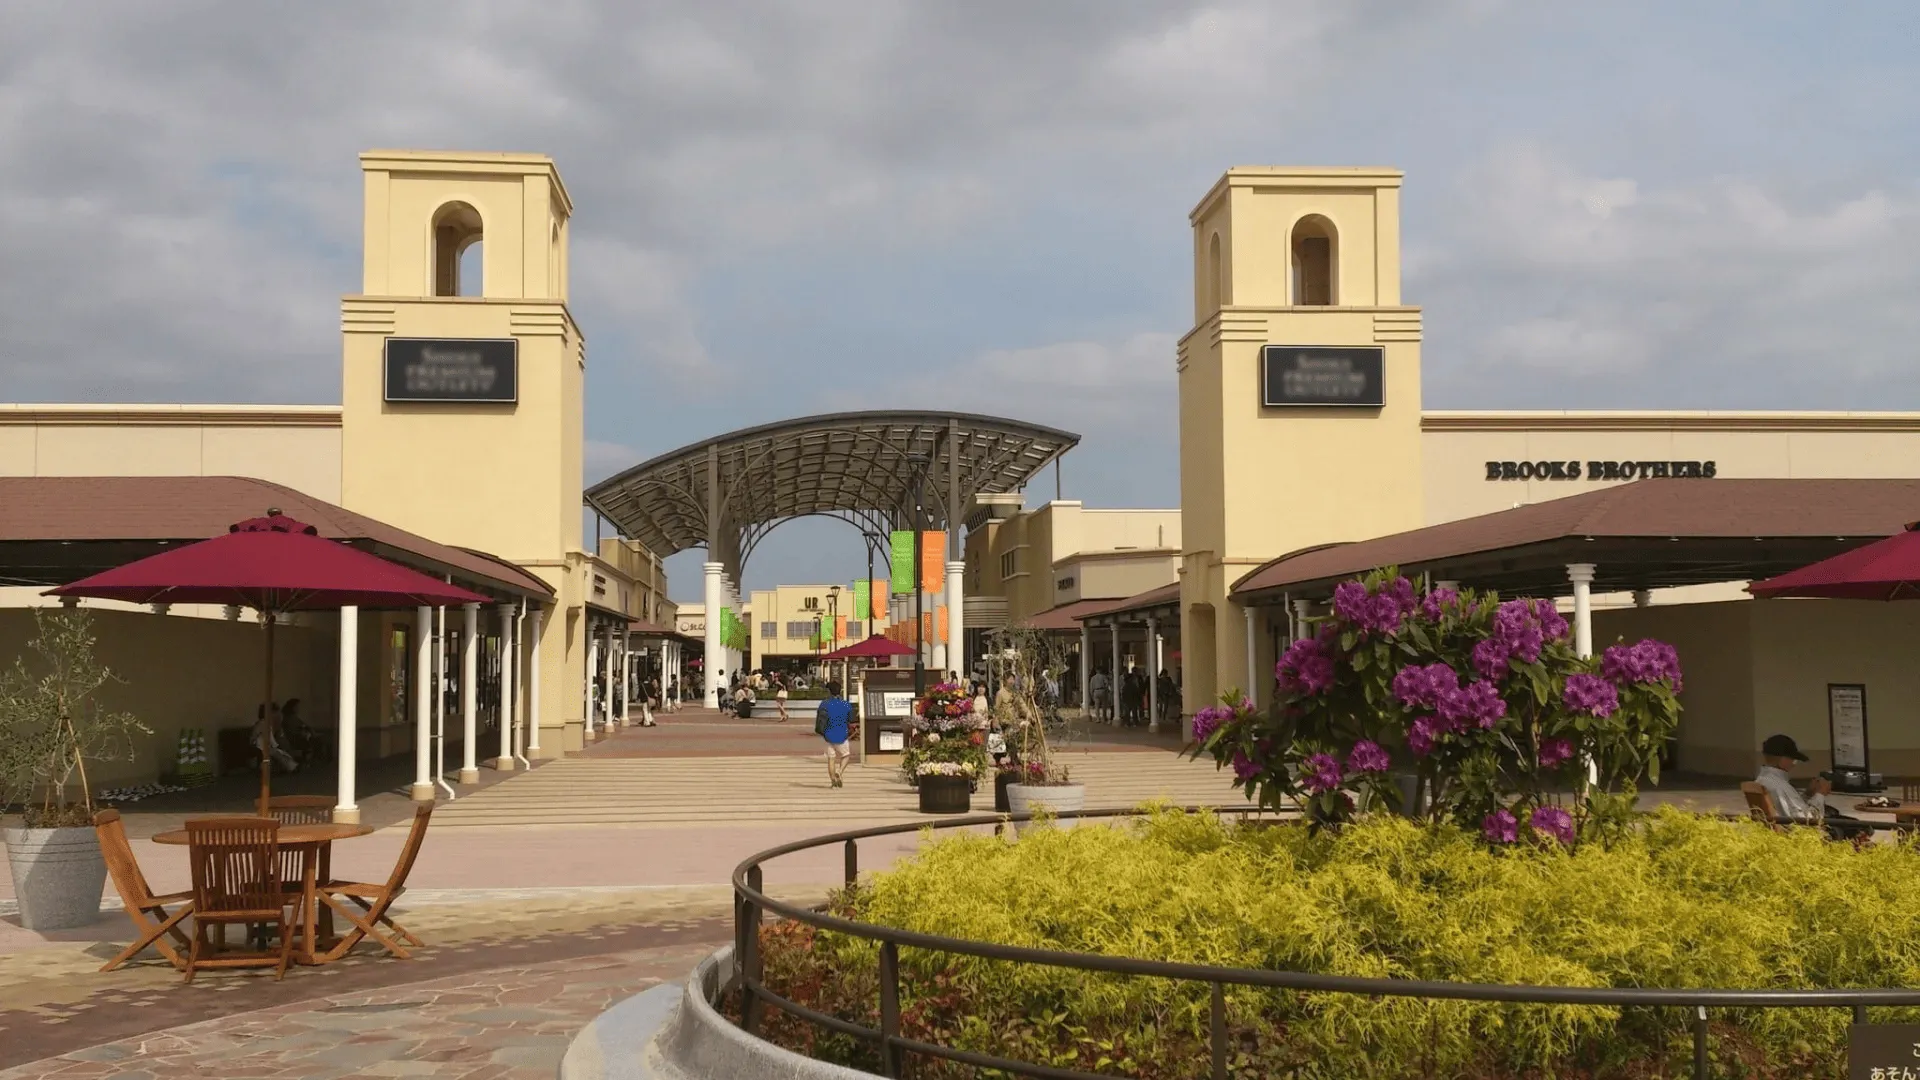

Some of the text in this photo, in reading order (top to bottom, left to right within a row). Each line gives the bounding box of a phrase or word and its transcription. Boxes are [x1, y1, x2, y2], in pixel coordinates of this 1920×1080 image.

[1485, 461, 1716, 479] BROOKS BROTHERS
[804, 596, 818, 609] UR
